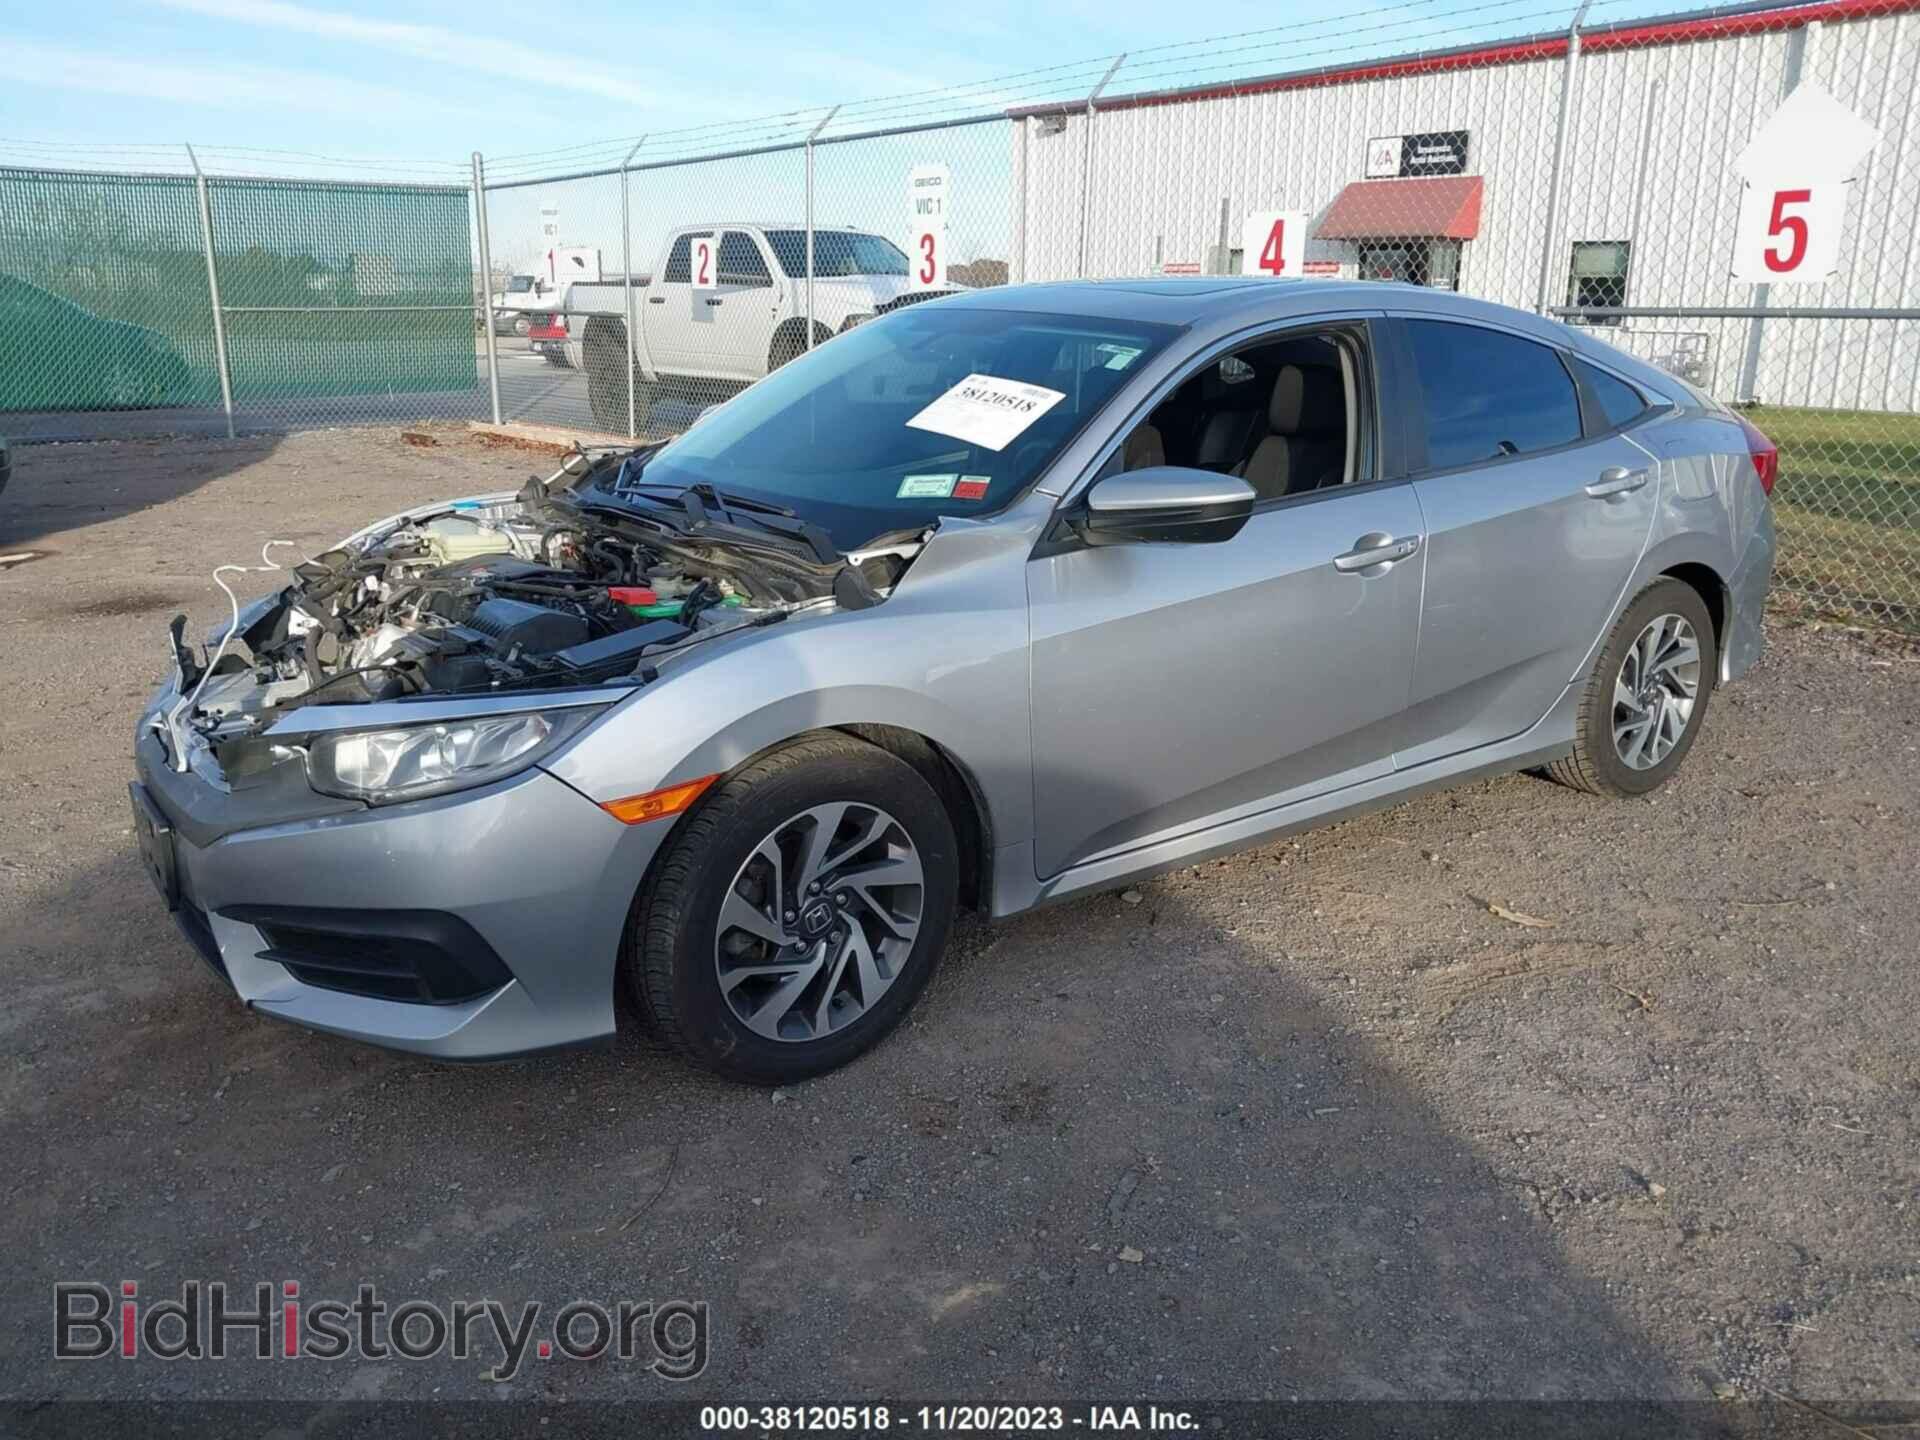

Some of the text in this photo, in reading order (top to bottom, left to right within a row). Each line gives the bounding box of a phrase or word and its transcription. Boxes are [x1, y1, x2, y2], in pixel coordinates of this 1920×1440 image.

[914, 176, 942, 187] GEICO
[916, 197, 941, 214] VIC 1
[1259, 219, 1286, 276] 4
[1763, 189, 1812, 273] 5
[548, 248, 555, 283] 1
[698, 243, 709, 284] 2
[920, 233, 936, 284] 3
[955, 386, 1038, 413] 38120518
